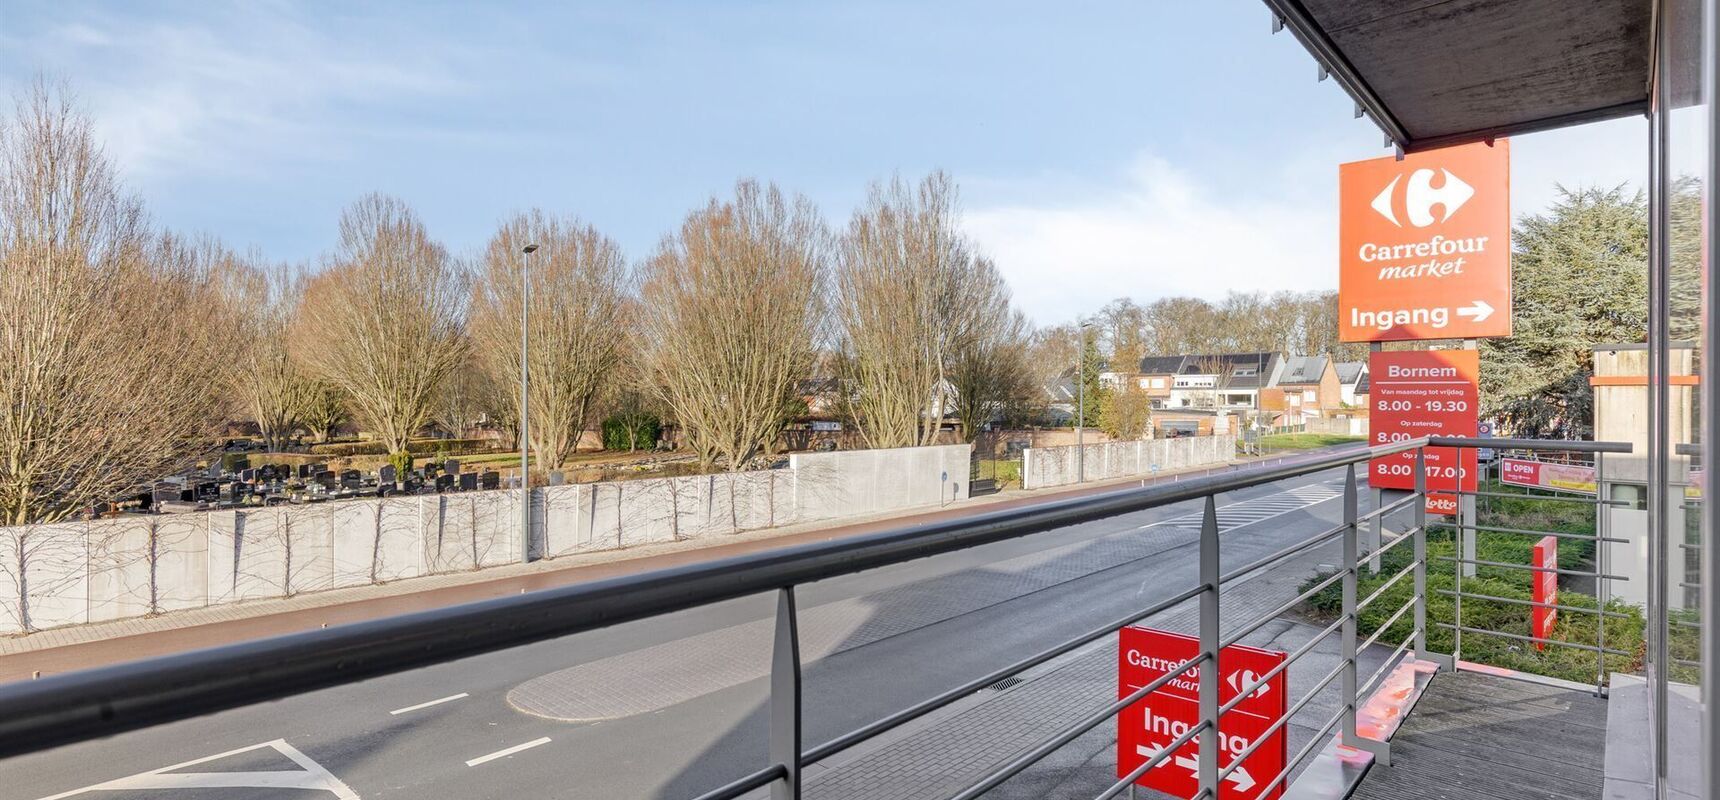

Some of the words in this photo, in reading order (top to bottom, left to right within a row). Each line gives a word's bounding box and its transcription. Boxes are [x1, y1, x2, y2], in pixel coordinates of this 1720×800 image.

[1359, 235, 1489, 262] Carrefour
[1378, 257, 1467, 280] market
[1352, 307, 1449, 330] Ingang
[1388, 365, 1457, 377] Bornem
[1378, 401, 1411, 411] 8.00
[1425, 401, 1468, 412] 19.30
[1377, 432, 1411, 442] 8.00
[1377, 464, 1411, 475] 8.00
[1425, 466, 1466, 478] 17.00
[1513, 464, 1534, 474] OPEN
